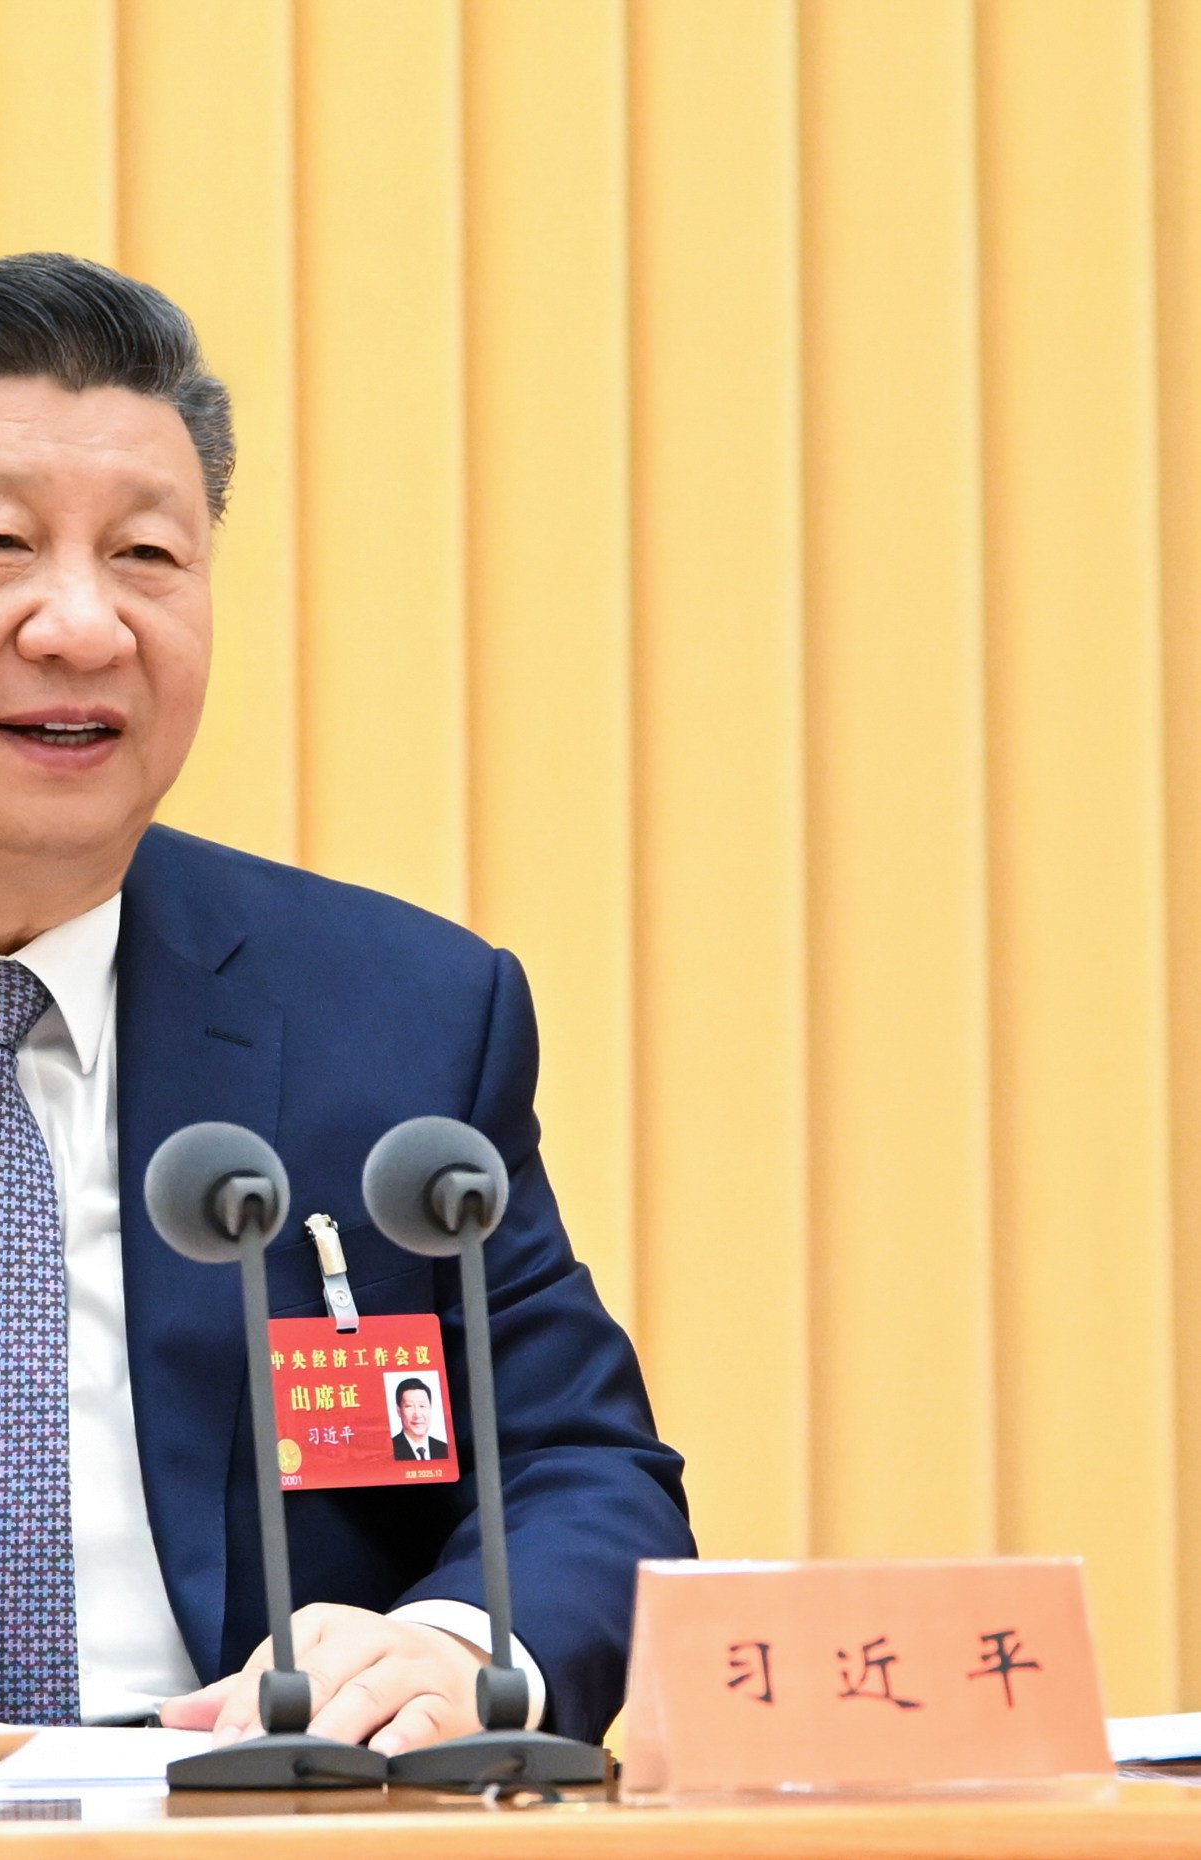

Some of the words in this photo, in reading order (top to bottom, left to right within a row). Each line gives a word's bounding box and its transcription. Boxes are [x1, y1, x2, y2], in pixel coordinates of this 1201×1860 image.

[271, 1346, 430, 1370] 中央经济工作会议
[291, 1384, 360, 1411] 出席证
[308, 1426, 355, 1445] 习近平
[727, 1629, 1041, 1709] 习近平
